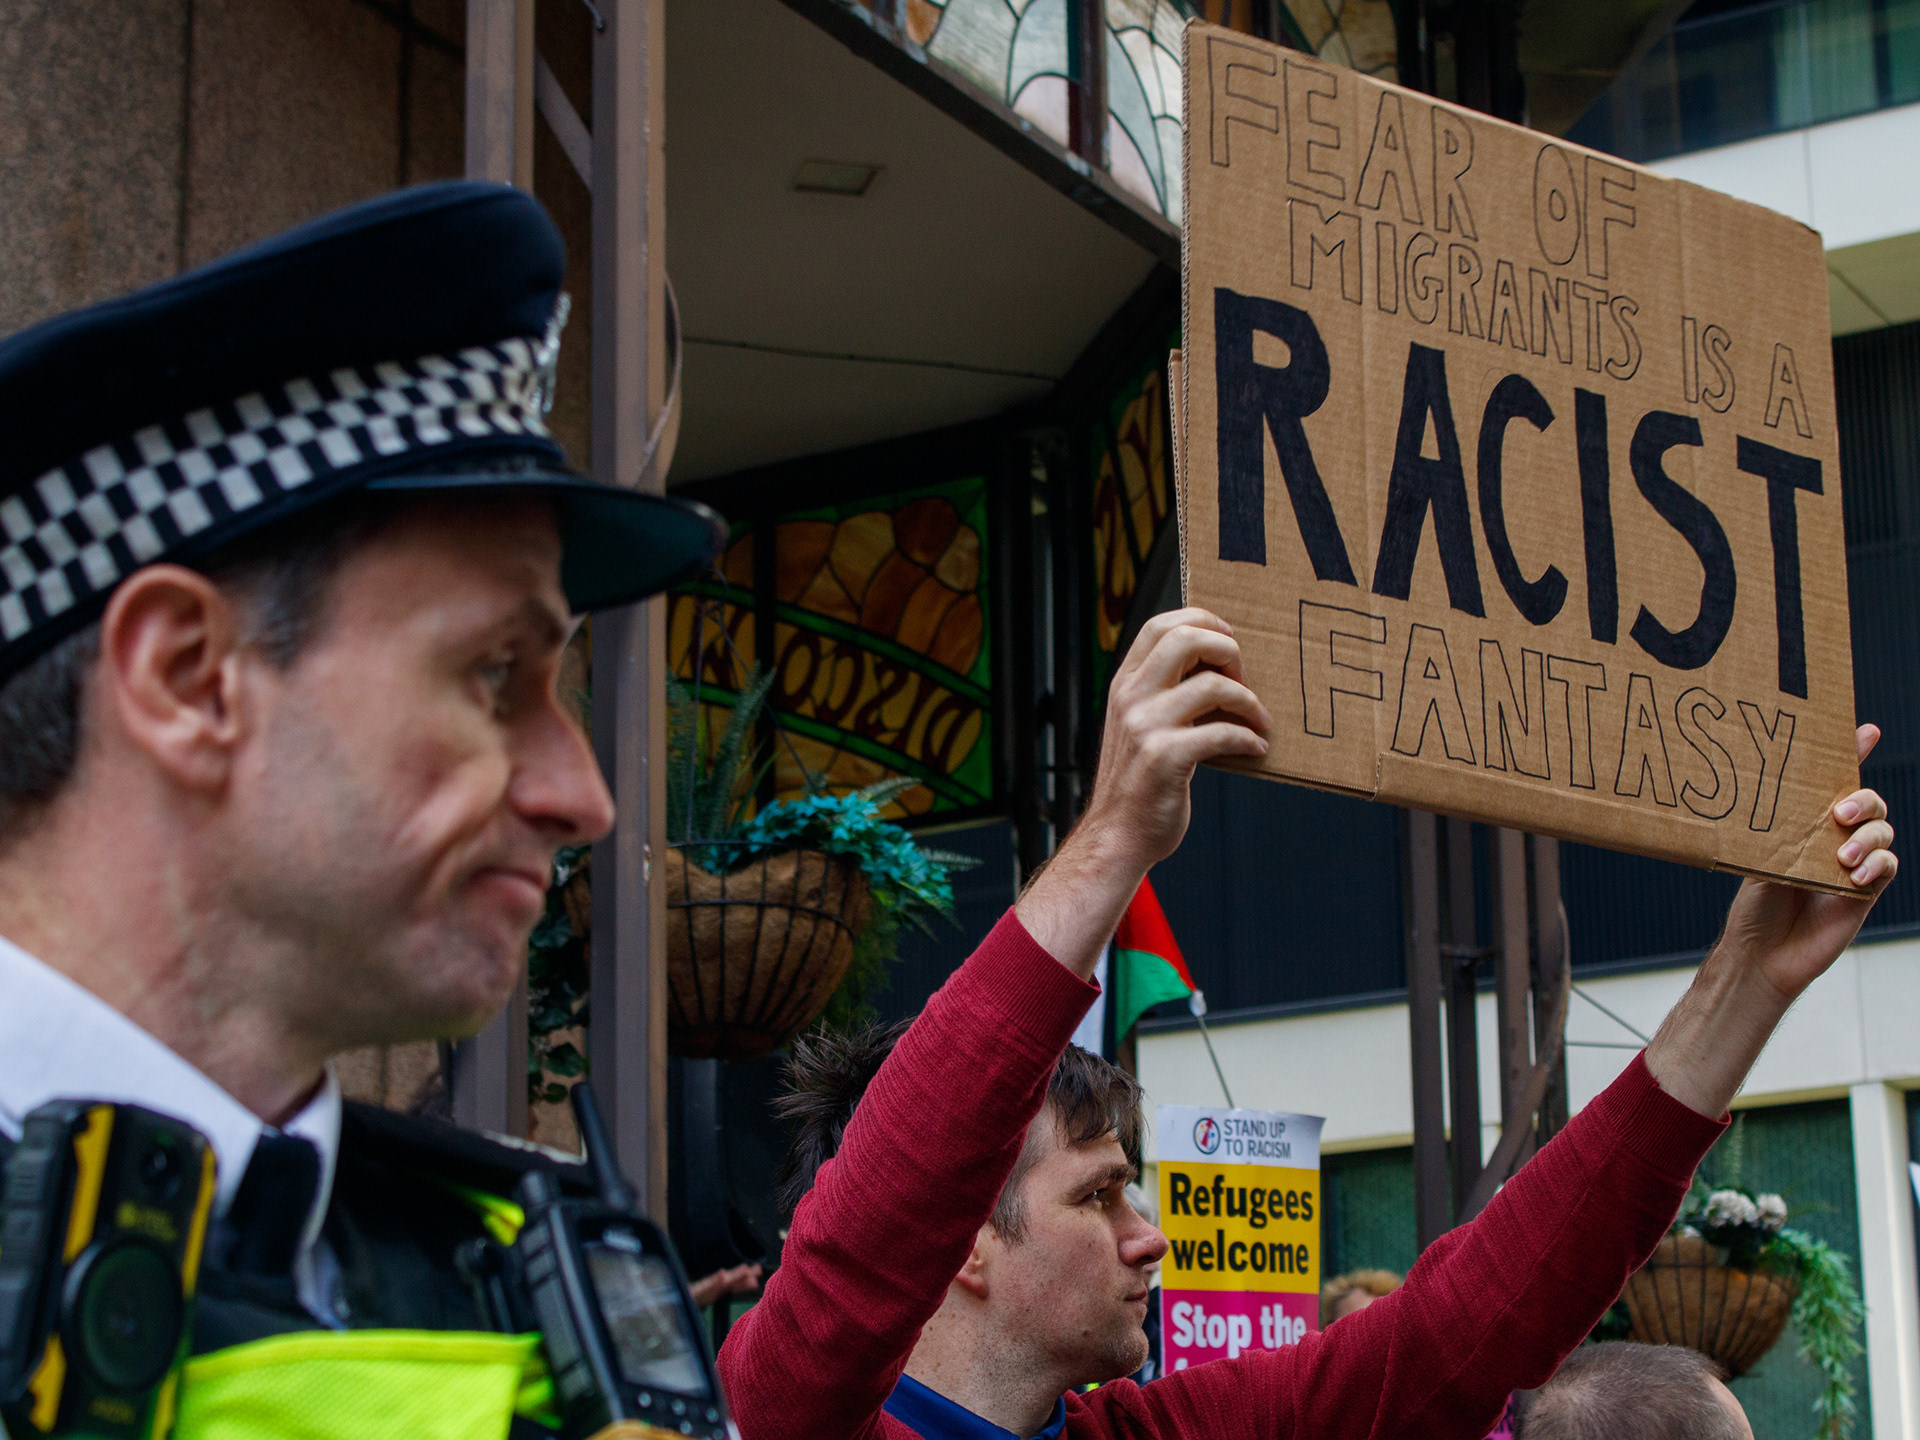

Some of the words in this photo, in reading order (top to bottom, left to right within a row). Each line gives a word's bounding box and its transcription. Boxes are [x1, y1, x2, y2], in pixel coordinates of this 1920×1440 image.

[1206, 36, 1479, 242] FEAR
[1533, 143, 1637, 280] OF
[1288, 198, 1643, 381] MIGRANTS
[1681, 316, 1736, 414] IS
[1764, 342, 1813, 440] A
[1213, 286, 1824, 700] RACIST
[1299, 599, 1796, 832] FANTASY
[1224, 1118, 1267, 1138] STAND
[1269, 1120, 1287, 1140] UP
[1224, 1138, 1244, 1156] TO
[1247, 1139, 1292, 1160] RACISM
[1169, 1171, 1314, 1229] Refugees
[1171, 1229, 1310, 1275] welcome
[1171, 1300, 1252, 1360] Stop
[1260, 1302, 1307, 1350] the
